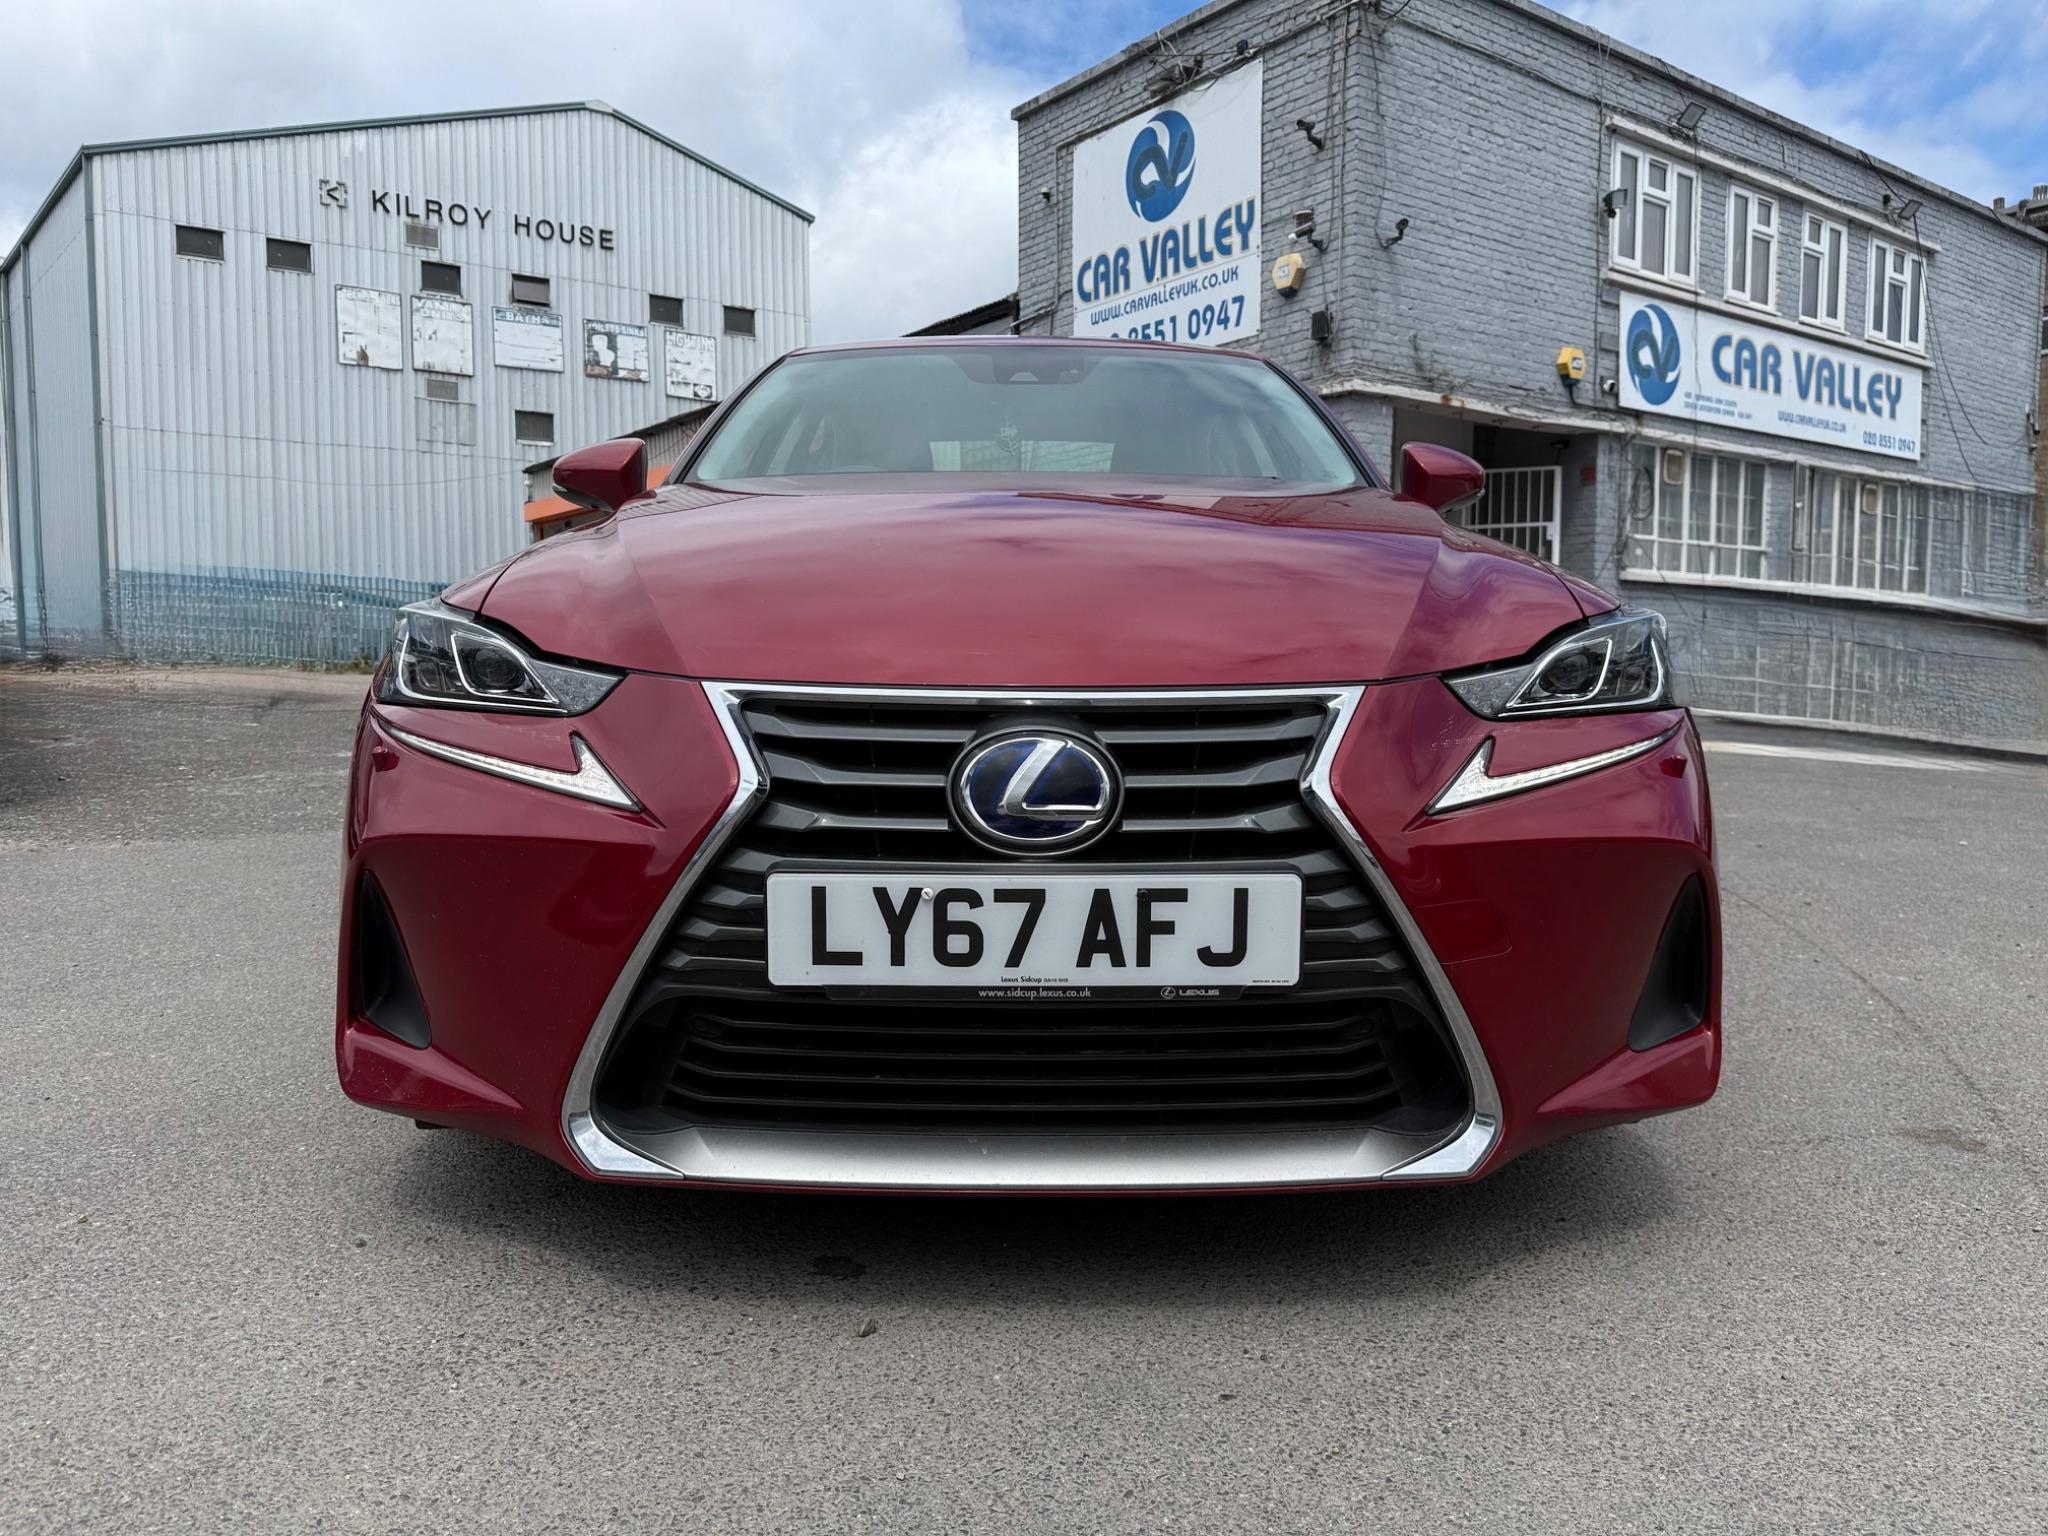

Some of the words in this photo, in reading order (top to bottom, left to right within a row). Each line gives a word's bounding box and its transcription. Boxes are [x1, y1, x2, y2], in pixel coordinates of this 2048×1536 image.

[371, 189, 491, 229] KILROY
[514, 214, 615, 251] HOUSE
[1077, 244, 1131, 303] CAR
[1139, 196, 1256, 284] VALLEY
[505, 311, 550, 324] BATHS
[1188, 295, 1245, 340] 0947
[1711, 334, 1782, 394] CAR
[1792, 349, 1903, 420] VALLEY
[1862, 430, 1877, 446] 020
[1898, 436, 1916, 453] 0947
[811, 886, 1047, 968] LY67
[1075, 888, 1249, 968] AFJ
[978, 987, 1092, 1000] www.sidcup.lexus.co.uk
[1020, 975, 1042, 984] Sidcup
[1179, 988, 1220, 996] LEXUS
